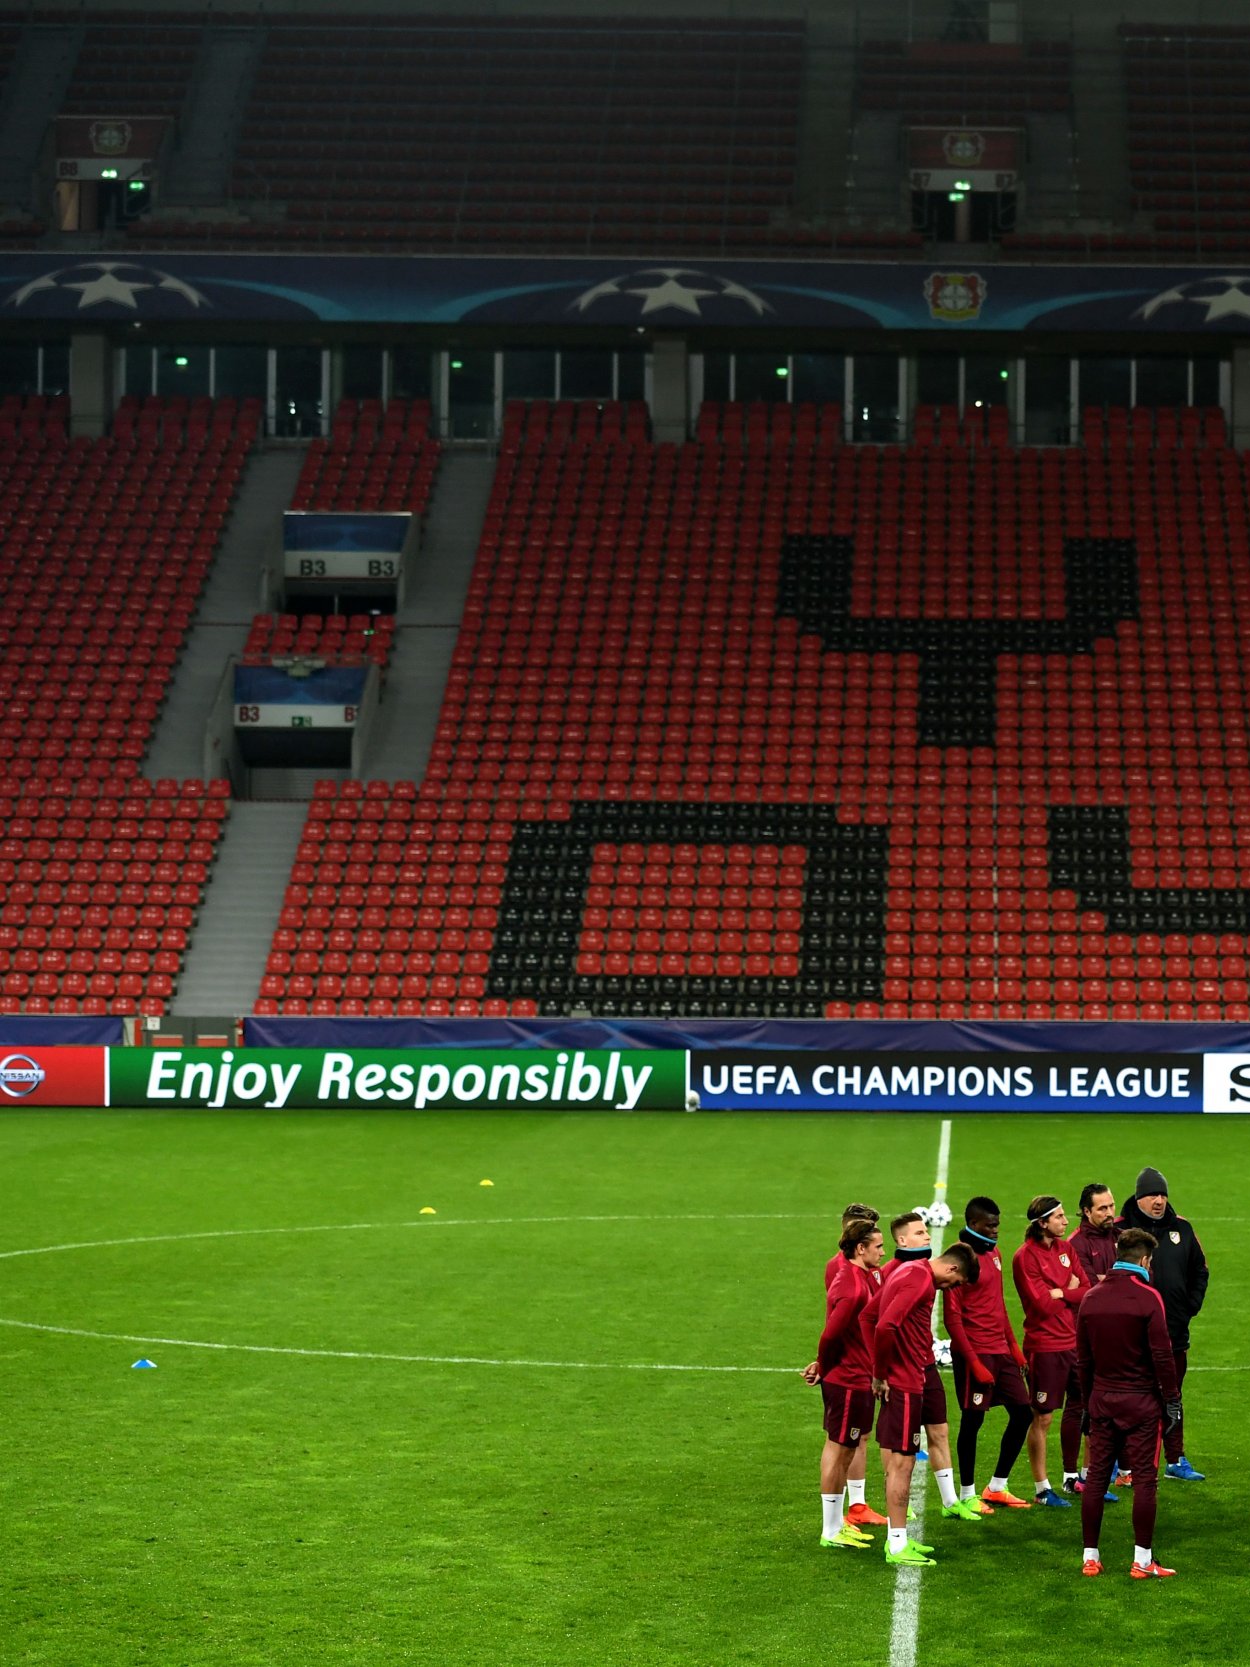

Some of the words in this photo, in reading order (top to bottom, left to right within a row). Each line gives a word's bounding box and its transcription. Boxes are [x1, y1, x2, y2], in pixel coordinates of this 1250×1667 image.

[300, 559, 326, 577] B3
[368, 560, 394, 577] B3
[239, 706, 260, 722] B3
[147, 1052, 301, 1108] Enjoy
[318, 1052, 653, 1109] Responsibly
[703, 1065, 800, 1095] UEFA
[812, 1066, 1033, 1097] CHAMPIONS
[1049, 1067, 1190, 1098] LEAGUE
